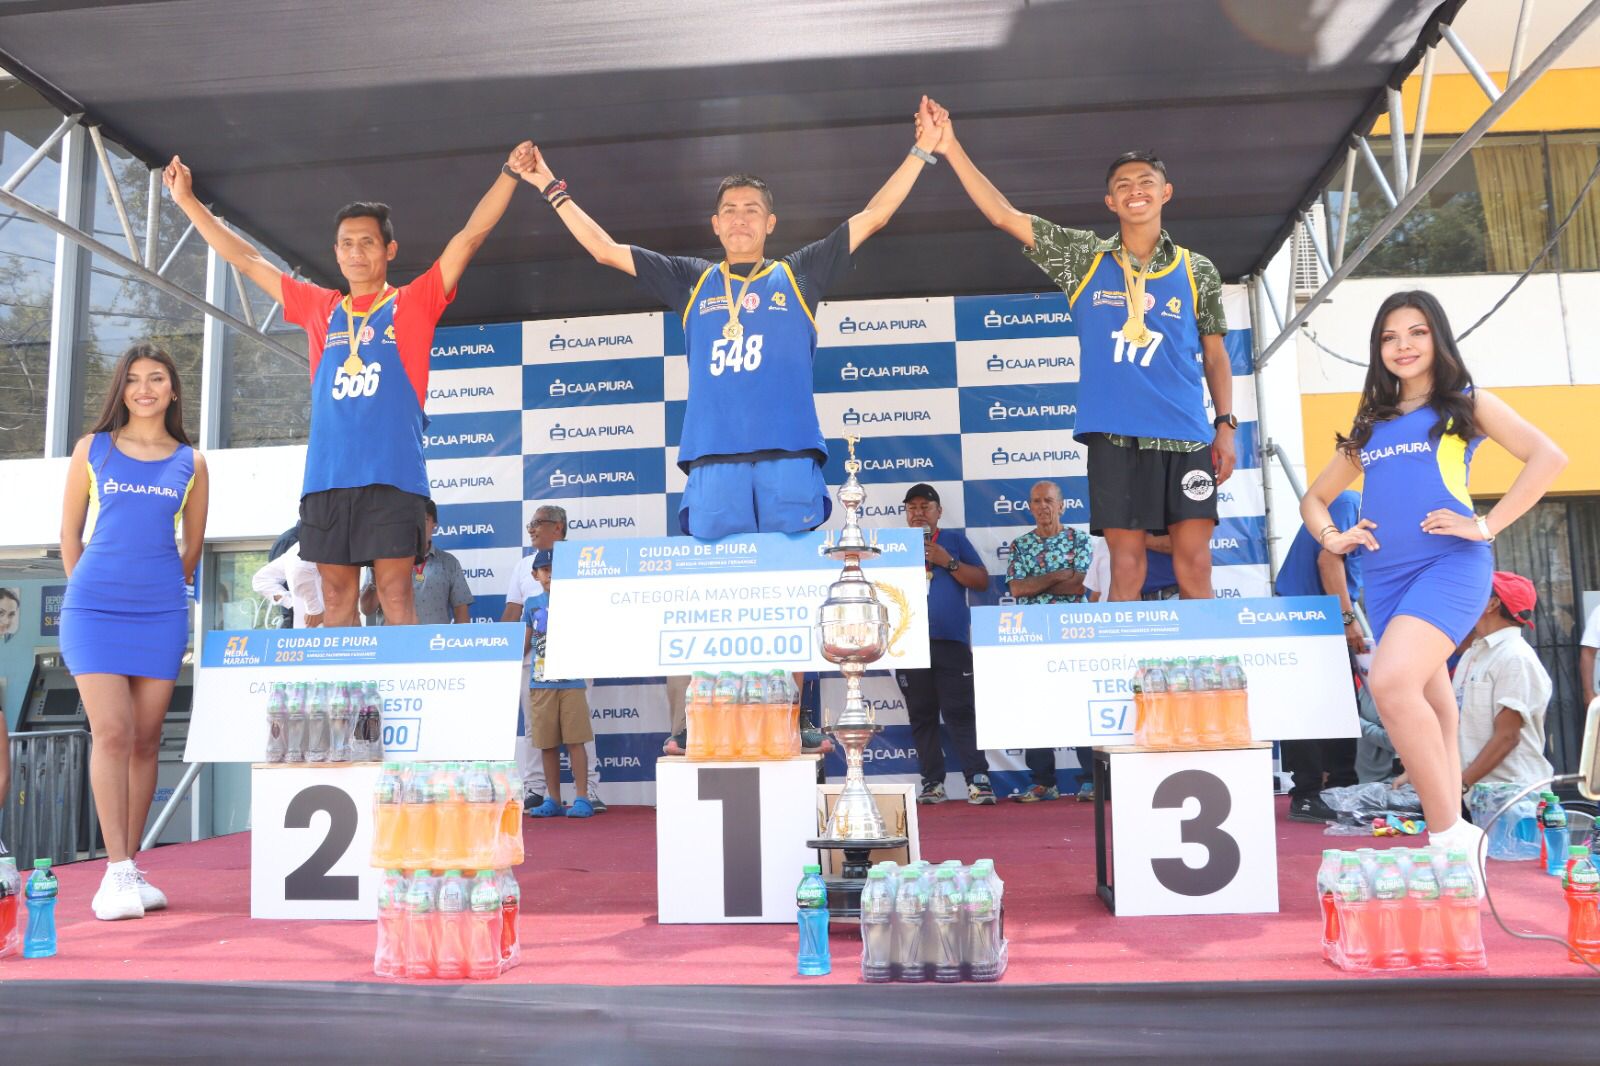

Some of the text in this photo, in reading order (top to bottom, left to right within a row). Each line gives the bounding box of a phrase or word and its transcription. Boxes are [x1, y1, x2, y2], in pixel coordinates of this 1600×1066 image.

[1003, 312, 1072, 324] CAJA PIURA
[858, 319, 926, 331] CAJA PIURA
[568, 335, 633, 348] CAJA PIURA
[431, 344, 495, 357] CAJA PIURA
[710, 334, 764, 376] 548
[1006, 357, 1074, 369] CAJA PIURA
[860, 365, 929, 378] CAJA PIURA
[332, 362, 381, 400] 566
[568, 380, 634, 393] CAJA PIURA
[431, 386, 494, 399] CAJA PIURA
[862, 410, 931, 423] CAJA PIURA
[1008, 405, 1077, 417] CAJA PIURA
[568, 425, 634, 438] CAJA PIURA
[430, 433, 495, 447] CAJA PIURA
[1011, 450, 1080, 463] CAJA PIURA
[1370, 441, 1432, 461] CAJA PIURA
[864, 457, 933, 470] CAJA PIURA
[430, 476, 494, 489] CAJA PIURA
[568, 471, 635, 484] CAJA PIURA
[119, 483, 178, 499] CAJA PIURA
[866, 506, 896, 516] CAJA
[1014, 501, 1029, 511] CA
[569, 517, 635, 529] CAJA PIURA
[432, 524, 494, 536] CAJA PIURA
[1209, 538, 1239, 549] IURA
[580, 546, 605, 562] 51
[639, 543, 757, 558] CIUDAD DE PIURA
[578, 559, 606, 568] MEDIA
[639, 560, 672, 572] 2023
[577, 566, 621, 576] MARATÓN
[610, 585, 829, 605] CATEGORÍA MAYORES VARO
[1216, 588, 1241, 598] URA
[664, 606, 808, 624] PRIMER PUESTO
[1000, 612, 1024, 631] 51
[1060, 611, 1179, 624] CIUDAD DE PIURA
[1257, 611, 1326, 622] CAJA PIURA
[999, 626, 1027, 634] MEDIA
[1062, 627, 1095, 639] 2023
[227, 636, 249, 651] 51
[277, 636, 377, 649] CIUDAD DE PIURA
[447, 637, 508, 648] CAJA PIURA
[999, 633, 1043, 643] MARATÓN
[669, 635, 803, 659] S/ 4000.00
[223, 656, 260, 664] MARATÓN
[275, 651, 304, 662] 2023
[1047, 655, 1138, 673] CATEGORÍA
[1239, 652, 1298, 667] ARONES
[400, 678, 466, 692] VARONES
[384, 698, 423, 712] ESTO
[873, 700, 904, 710] CAJA
[603, 708, 639, 719] PIURA
[1100, 706, 1127, 730] S/
[875, 749, 906, 759] CAJA
[604, 757, 641, 767] PIURA
[1151, 769, 1241, 897] 3
[284, 784, 359, 900] 2
[698, 767, 763, 918] 1
